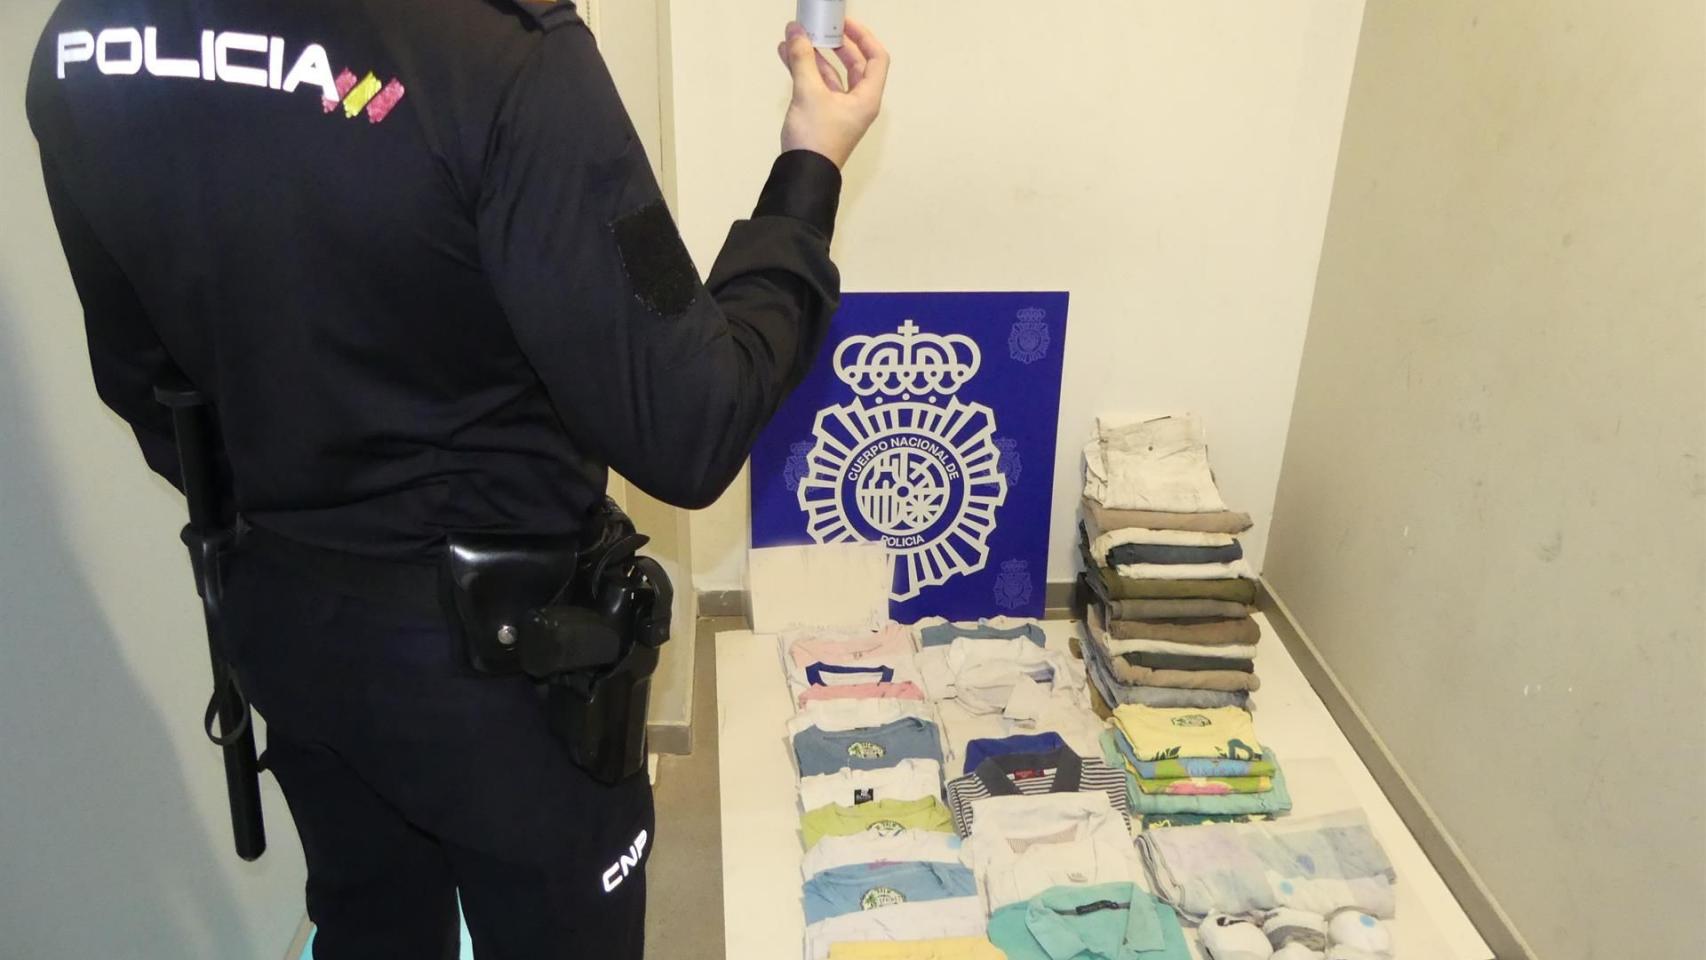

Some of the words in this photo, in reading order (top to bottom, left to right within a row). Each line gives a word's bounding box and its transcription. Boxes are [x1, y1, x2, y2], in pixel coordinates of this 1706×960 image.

[56, 25, 341, 103] POLICIA
[847, 440, 889, 481] CUERPO
[890, 436, 950, 465] NACIONAL
[944, 462, 960, 481] DE
[880, 534, 926, 547] POLICIA
[602, 829, 648, 893] CNP
